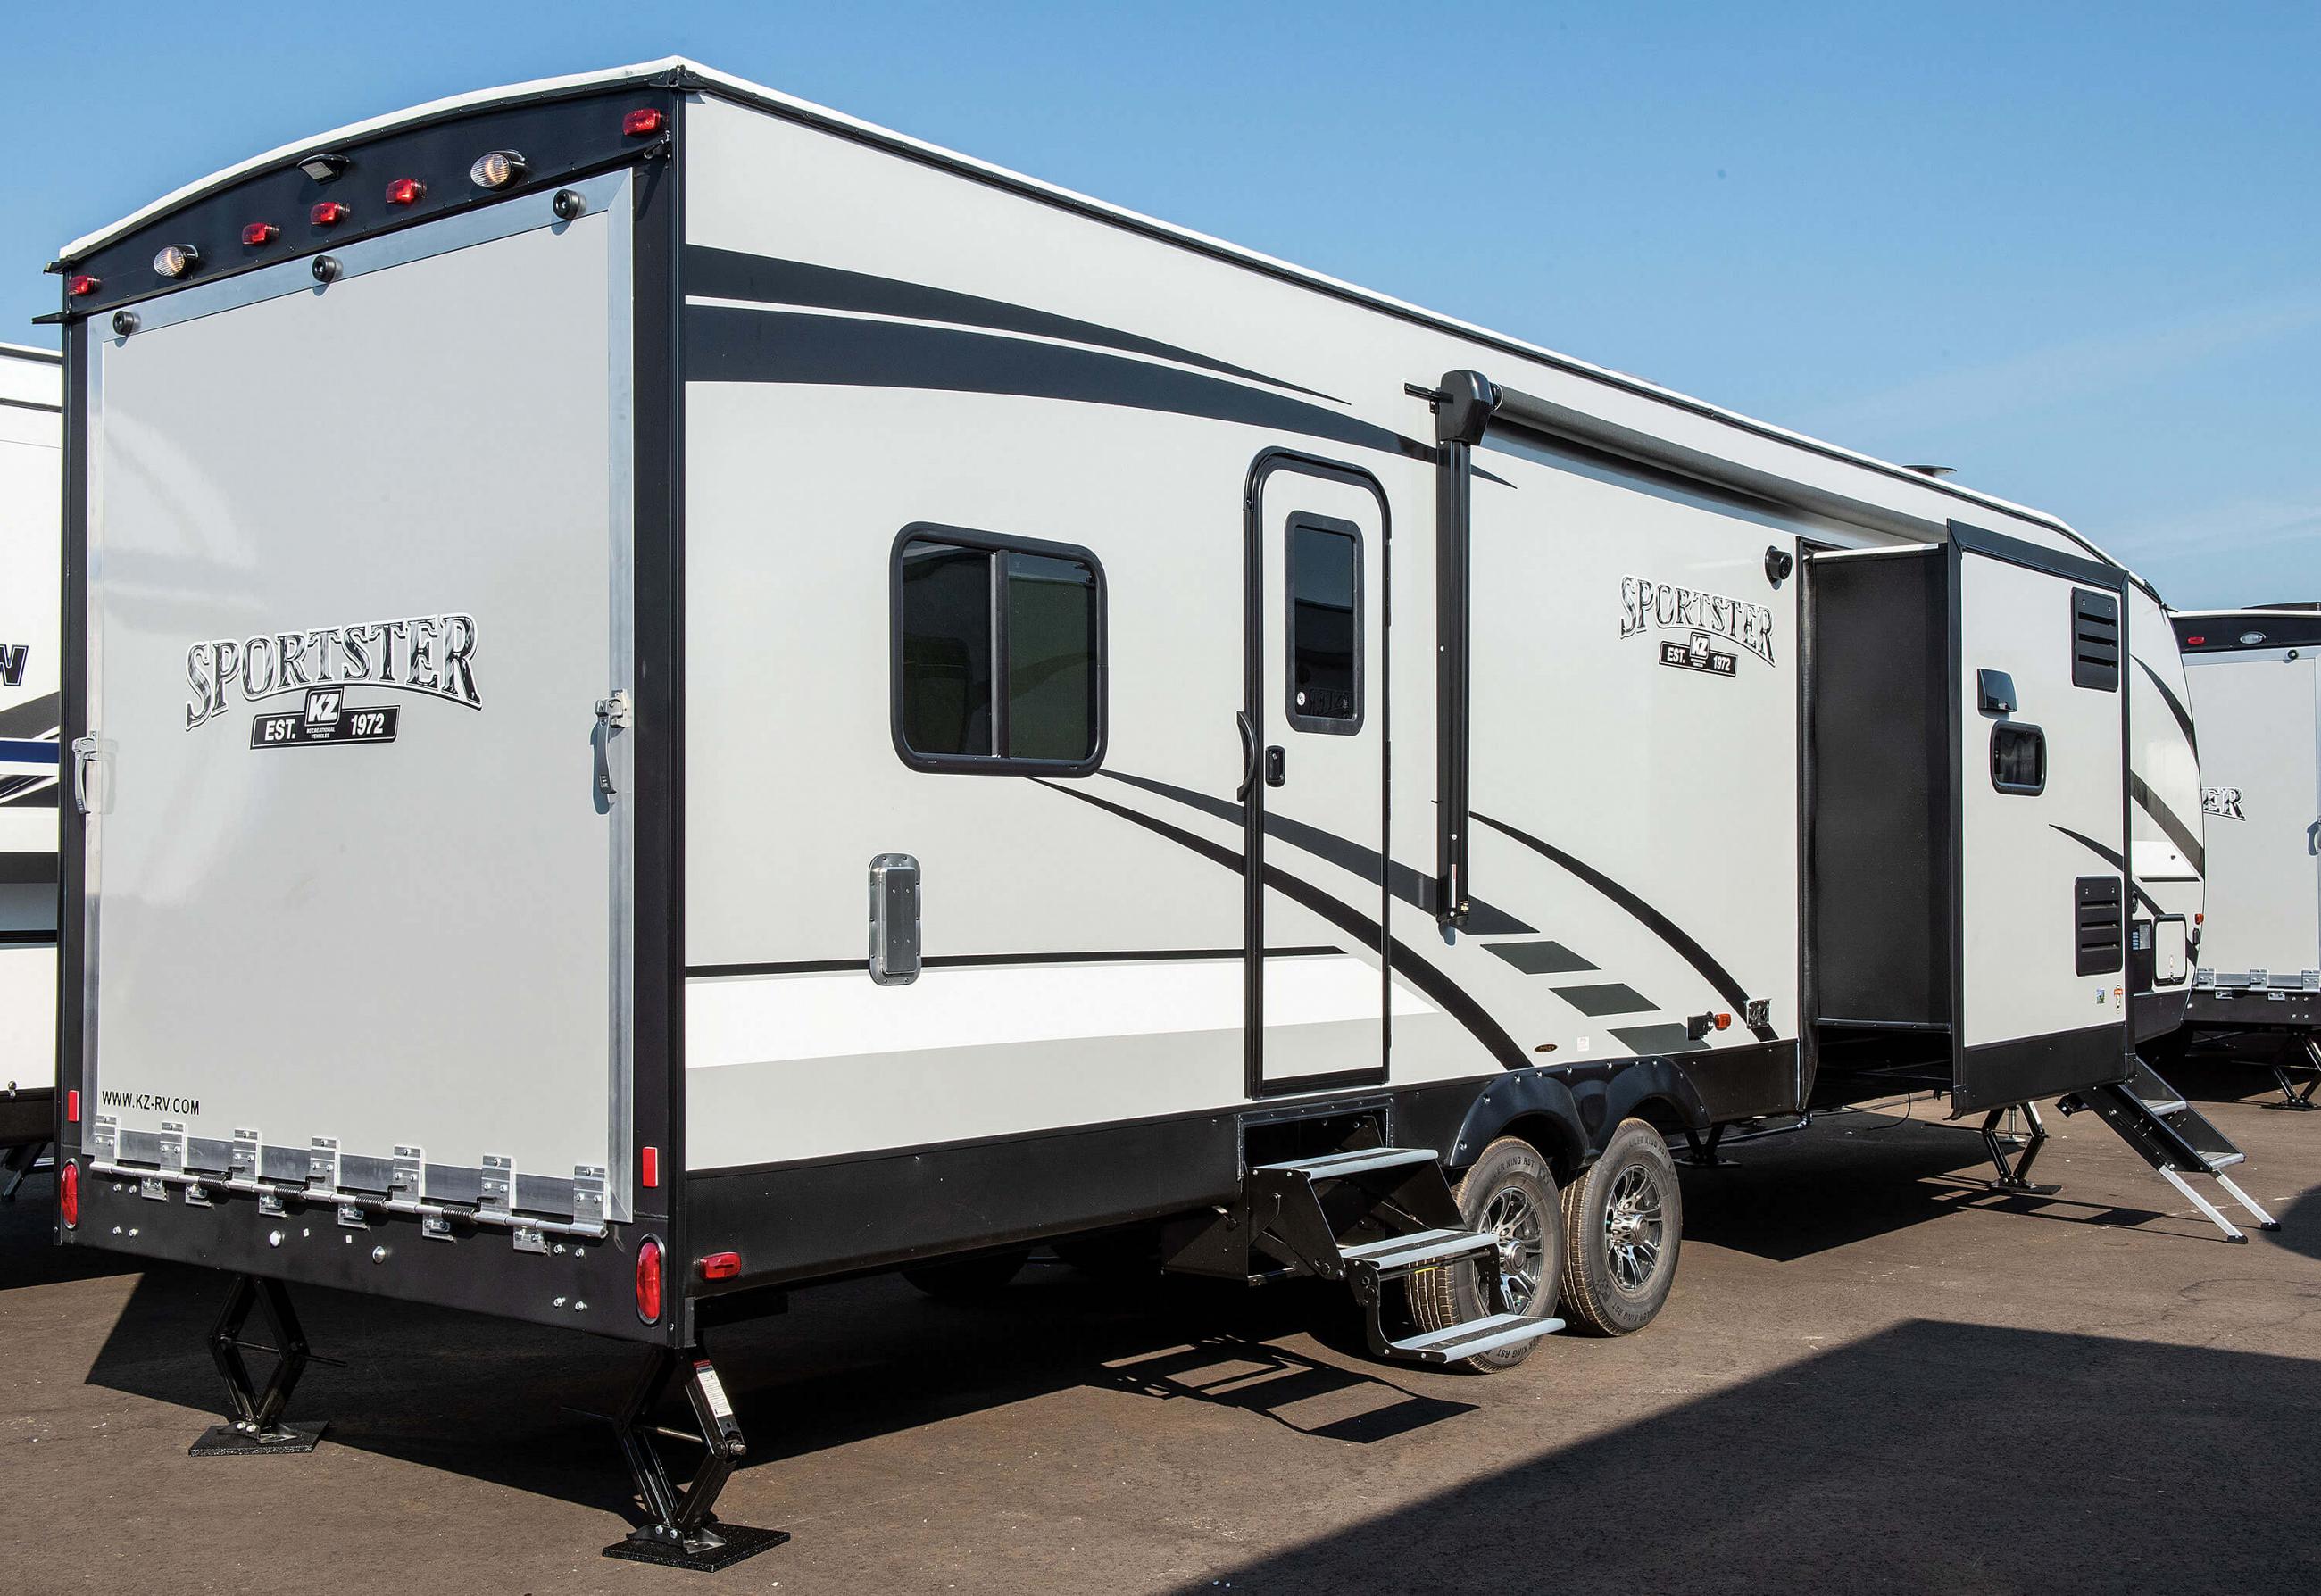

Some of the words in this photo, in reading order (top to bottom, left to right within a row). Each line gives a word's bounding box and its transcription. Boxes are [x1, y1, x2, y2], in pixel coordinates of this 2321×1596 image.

[1620, 576, 1775, 667] SPORTSTER
[1667, 646, 1685, 664] EST.
[1713, 654, 1731, 671] 1972
[1691, 636, 1709, 657] KZ
[185, 612, 482, 732] SPORTSTER
[307, 693, 340, 722] KZ
[264, 719, 296, 741] EST.
[351, 713, 385, 736] 1972
[102, 1090, 200, 1116] WWW.KZ-RV.COM
[1506, 1156, 1521, 1168] KING
[1523, 1157, 1535, 1168] RST
